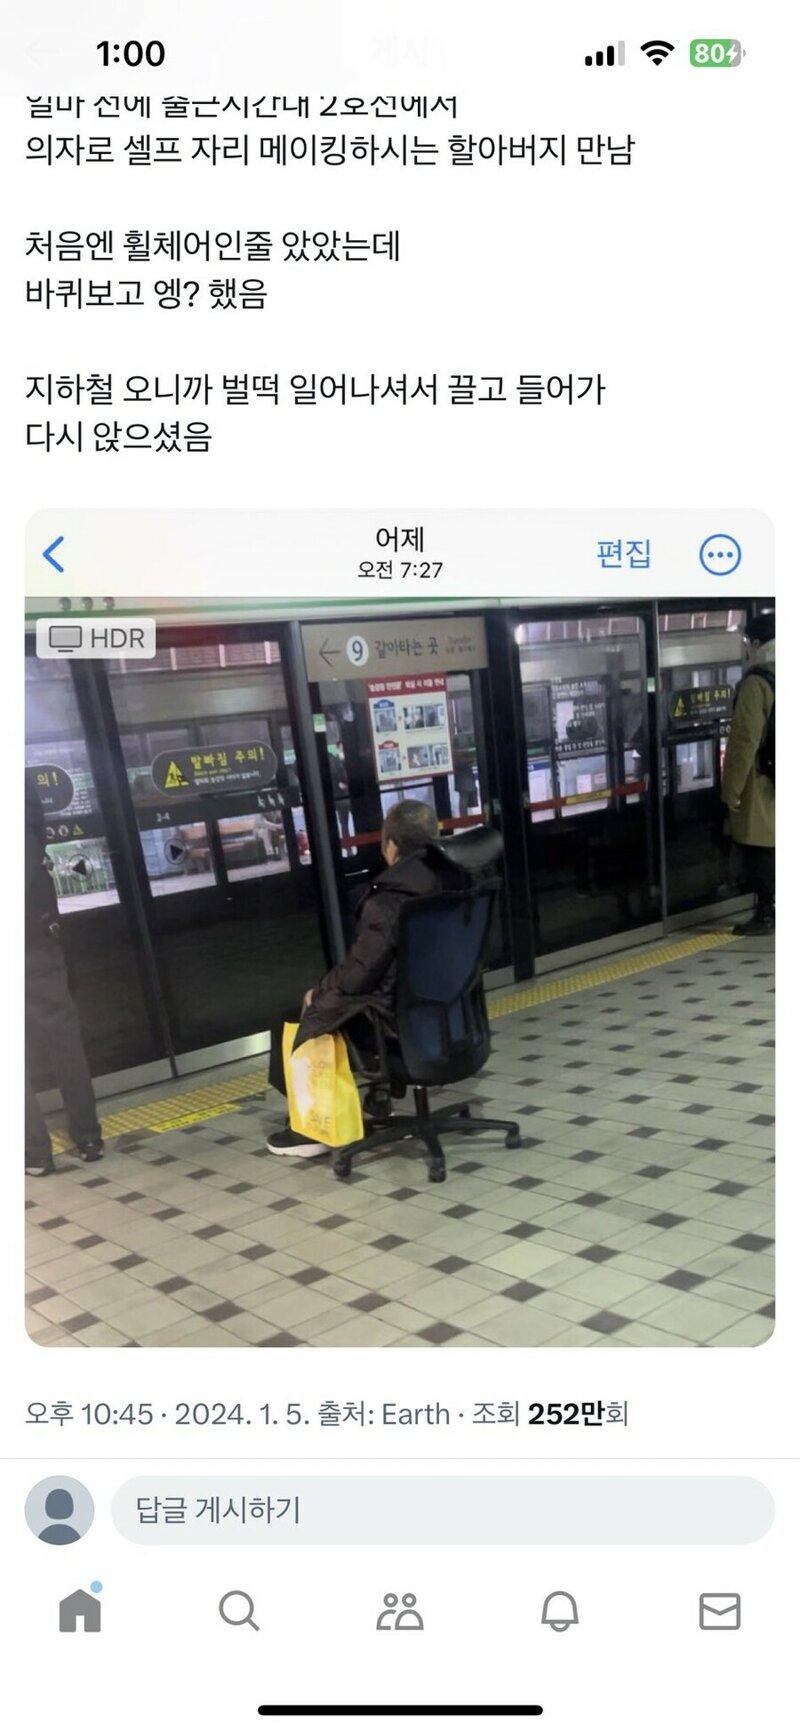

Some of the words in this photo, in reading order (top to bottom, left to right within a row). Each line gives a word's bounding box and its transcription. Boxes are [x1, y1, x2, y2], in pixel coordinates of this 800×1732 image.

[351, 640, 364, 662] 9
[190, 752, 229, 770] 발빠짐
[234, 746, 264, 764] 주의!
